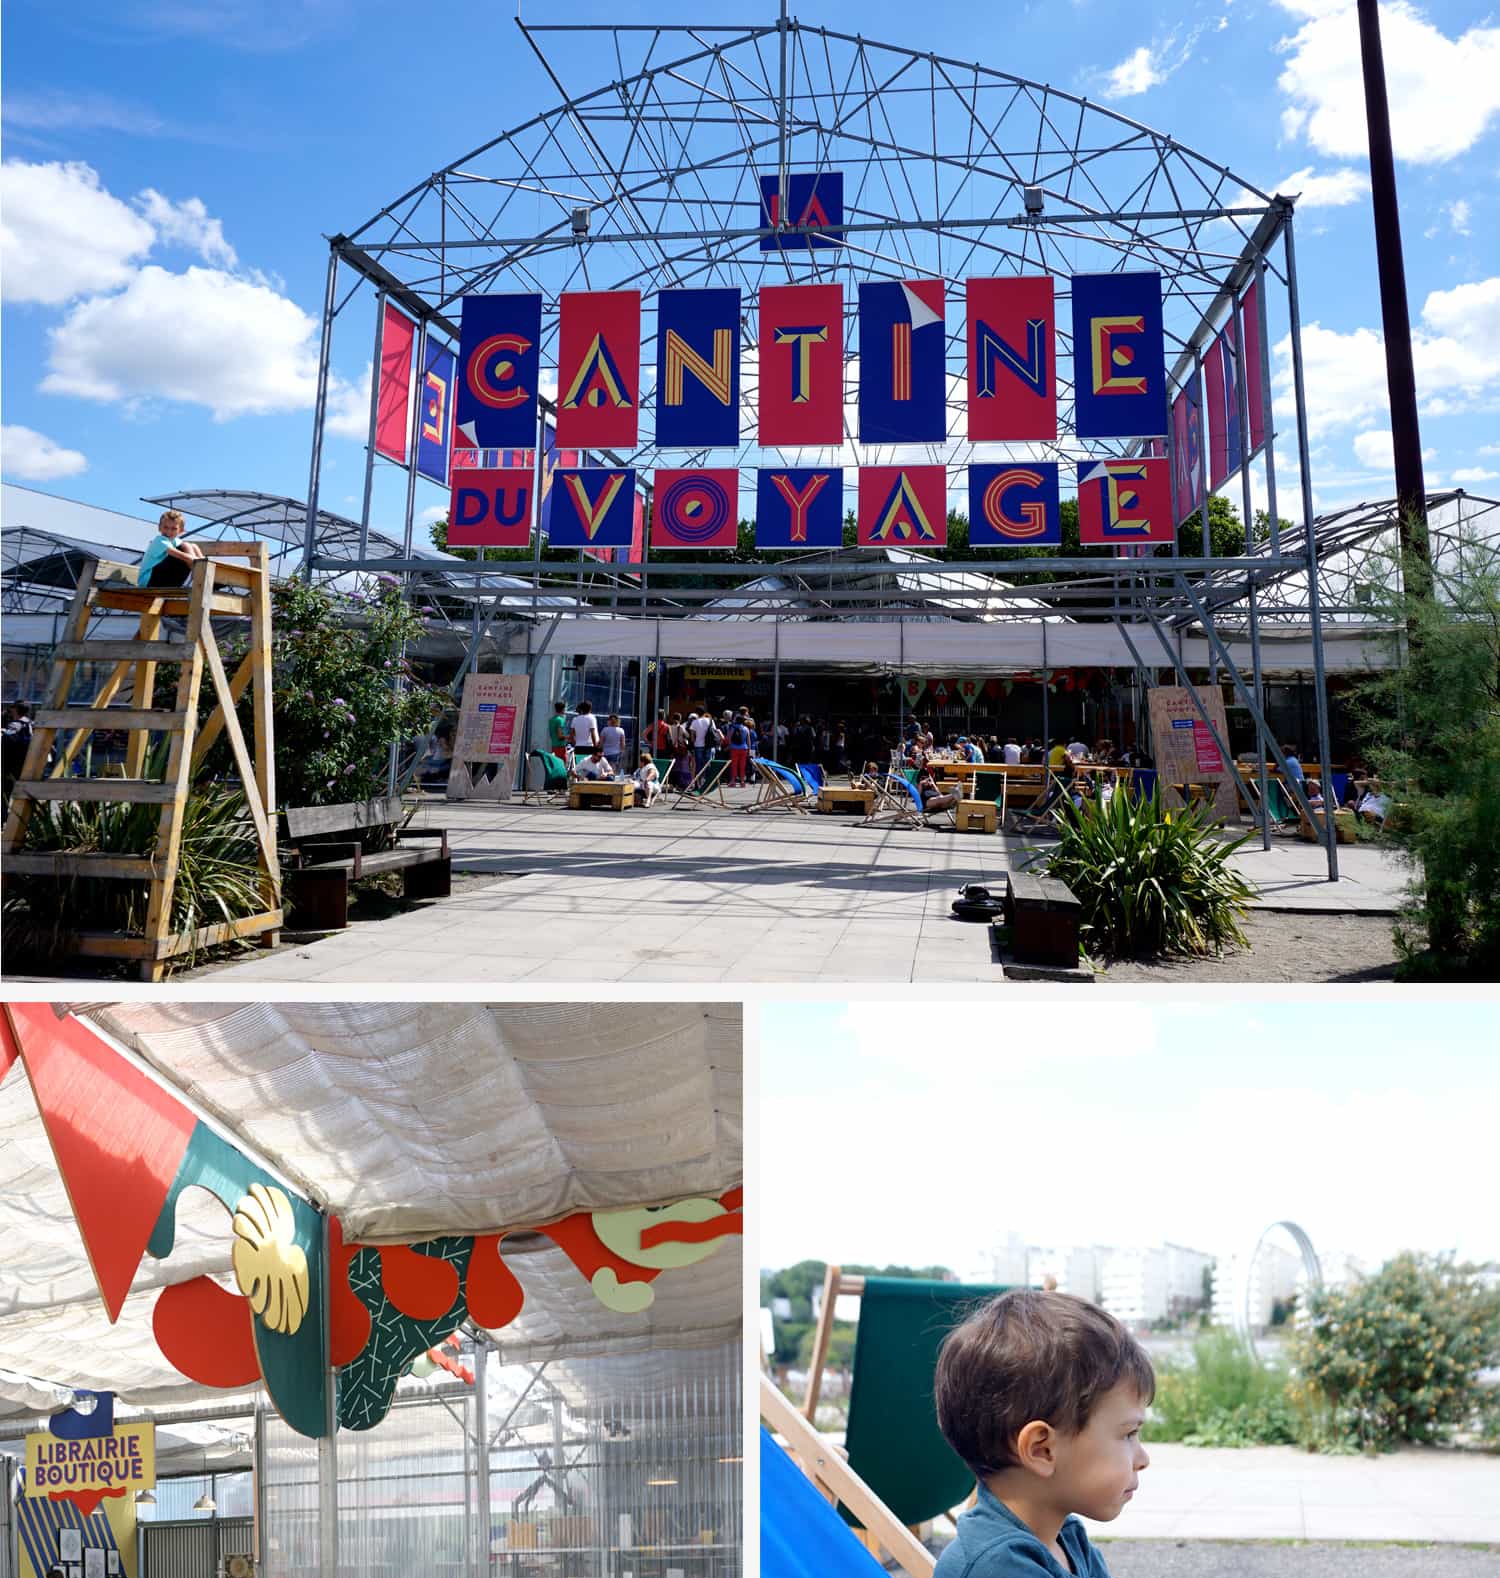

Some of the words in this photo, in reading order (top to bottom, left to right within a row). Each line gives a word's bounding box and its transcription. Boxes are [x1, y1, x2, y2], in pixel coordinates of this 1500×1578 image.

[771, 193, 832, 227] LA
[467, 315, 1148, 409] CANTINE
[455, 487, 527, 527] DU
[563, 464, 1150, 542] VOYAGE
[38, 1435, 140, 1465] LIBRAIRIE
[35, 1458, 143, 1487] BOUTIQUE
